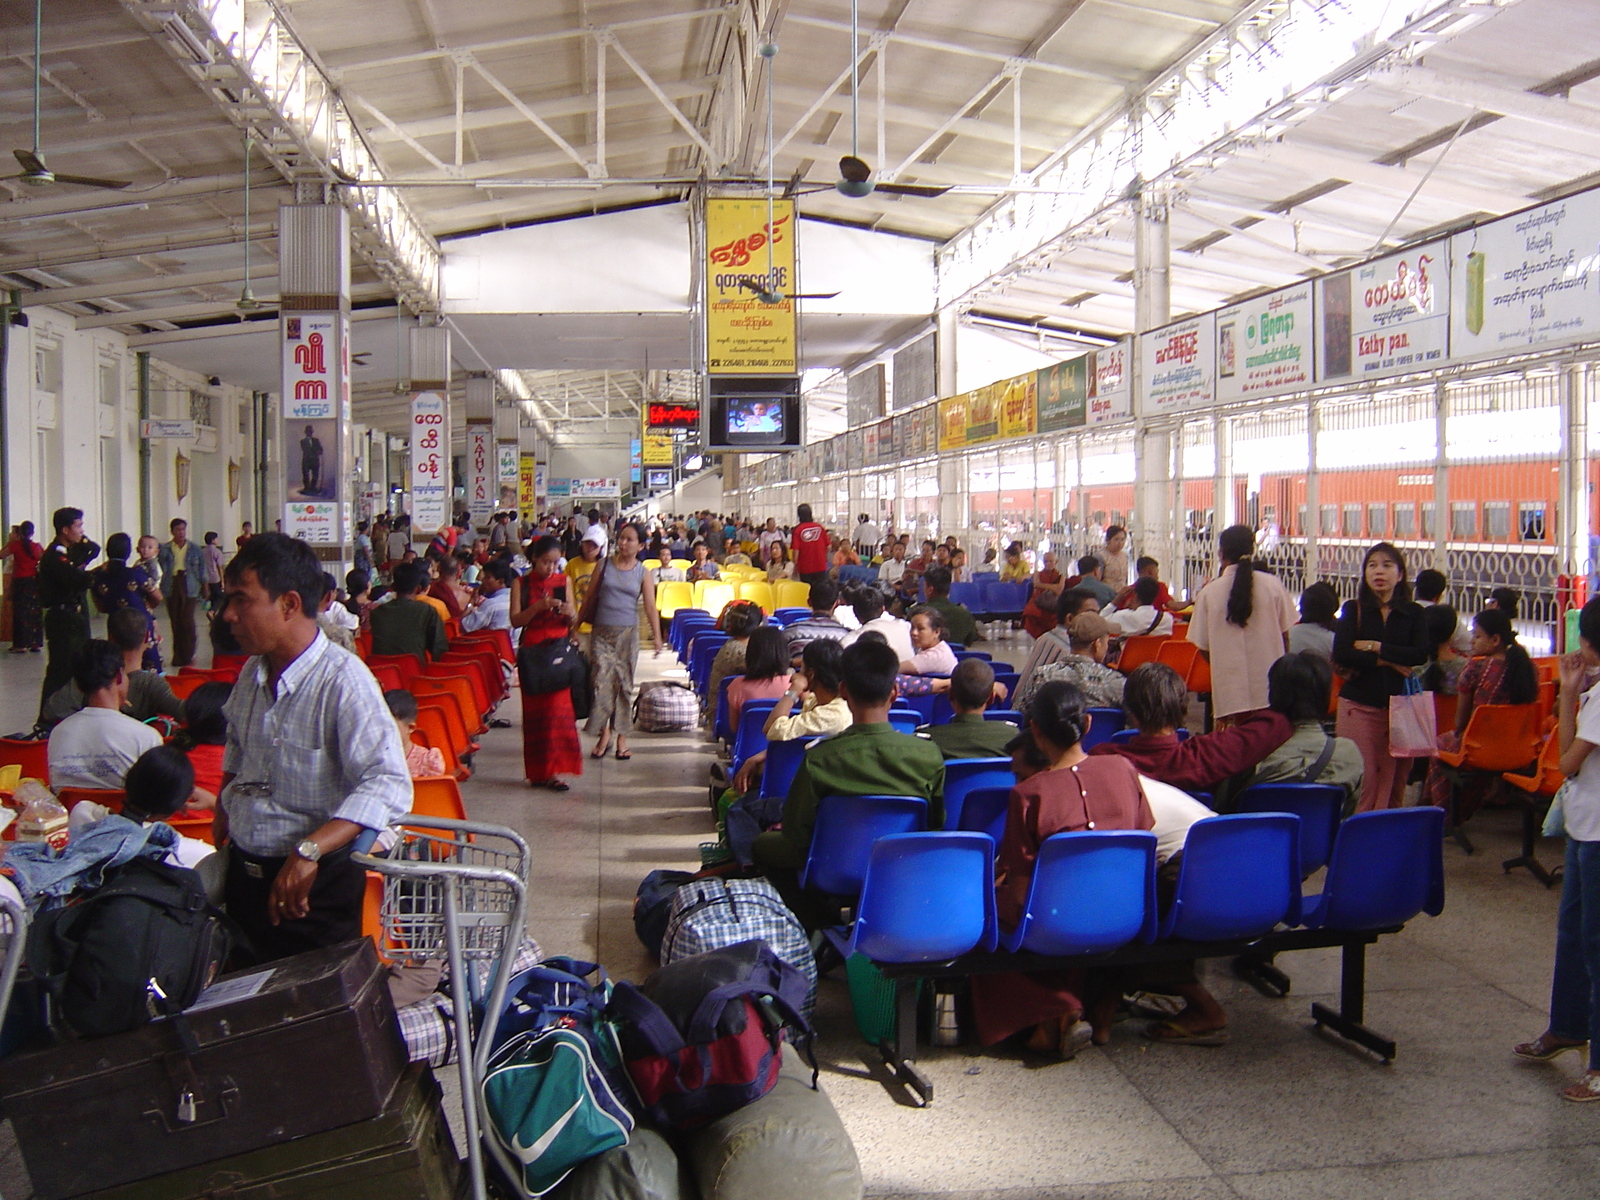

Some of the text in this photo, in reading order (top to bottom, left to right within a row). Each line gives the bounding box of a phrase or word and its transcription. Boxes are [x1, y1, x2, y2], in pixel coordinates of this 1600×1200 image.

[1358, 334, 1384, 357] Kathy
[474, 435, 486, 500] KATHY PAN
